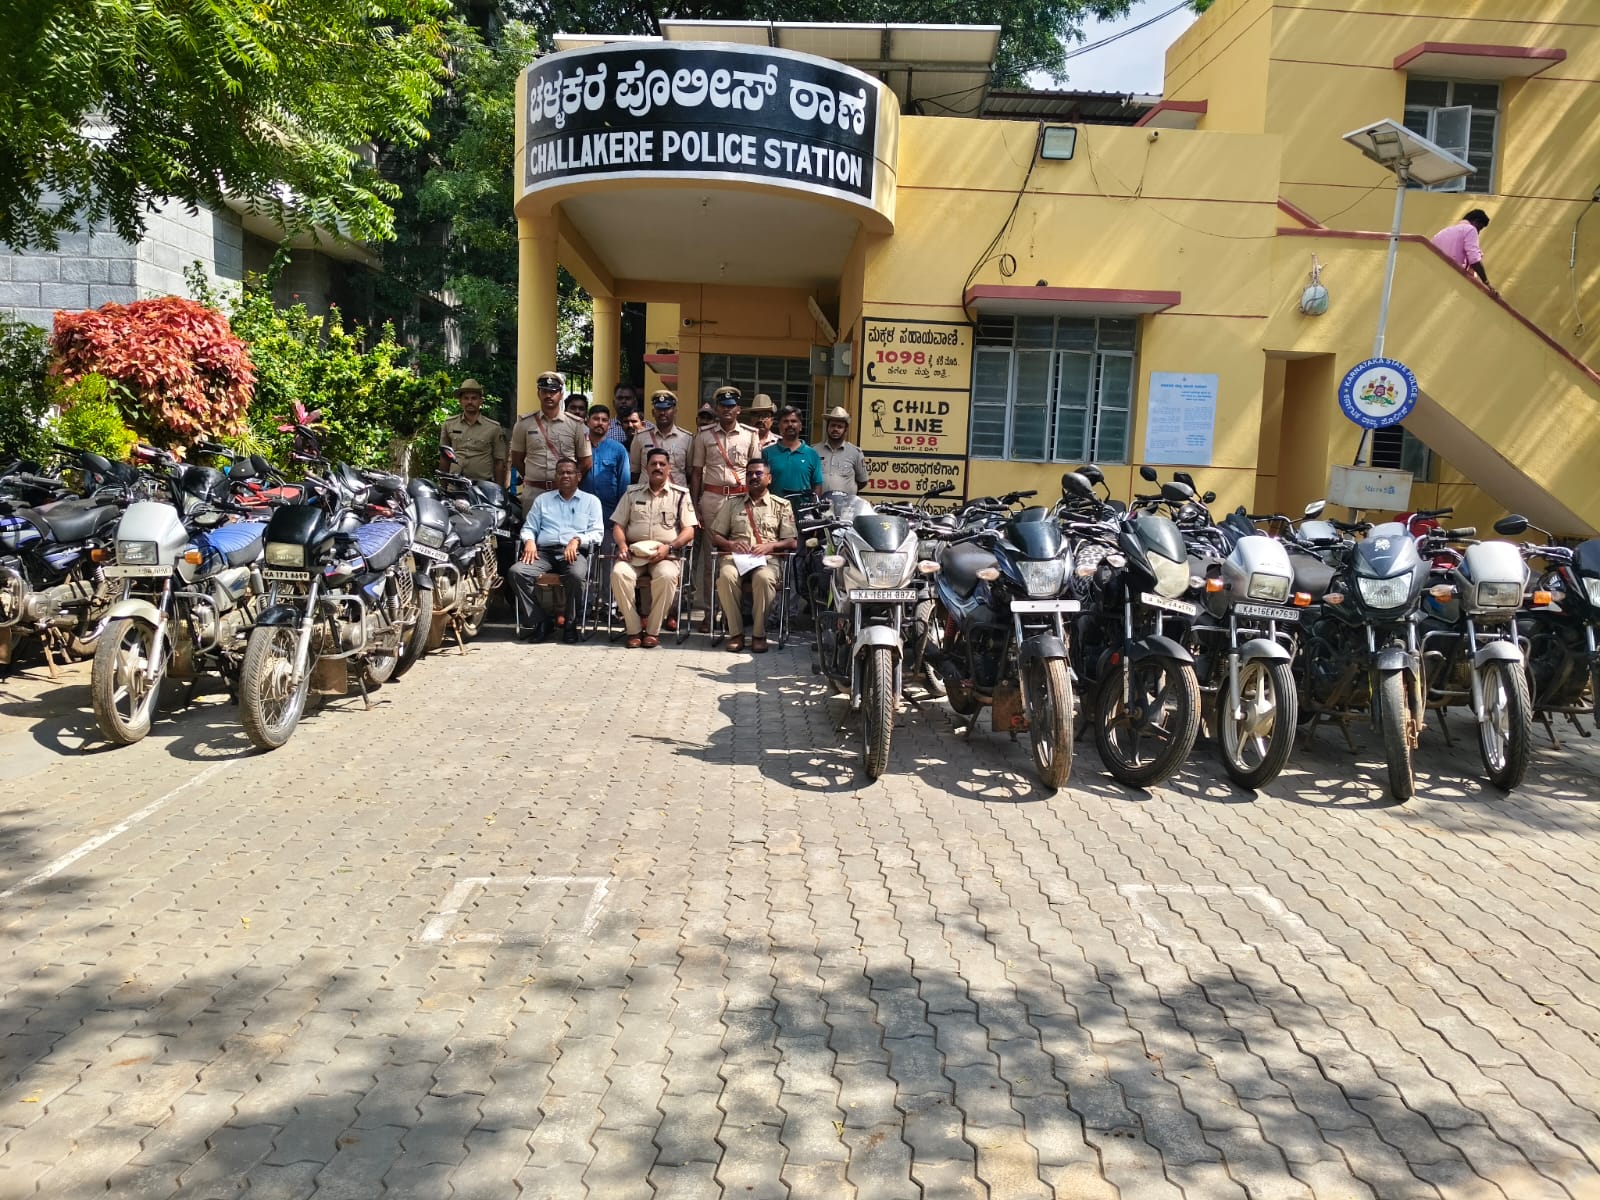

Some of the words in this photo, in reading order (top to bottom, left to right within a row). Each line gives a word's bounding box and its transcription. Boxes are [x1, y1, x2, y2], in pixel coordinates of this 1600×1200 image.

[530, 62, 607, 129] ಚಳ್ಳಕೆರೆ
[615, 60, 779, 117] ಪೊಲೀಸ್
[789, 78, 867, 136] ಠಾಣೆ
[530, 131, 653, 175] CHALLAKERE
[662, 131, 757, 166] POLICE
[764, 138, 863, 188] STATION
[876, 350, 926, 365] 1098
[1344, 358, 1385, 387] KARNATAKA
[1385, 359, 1408, 373] STATE
[1406, 372, 1418, 398] POLICE
[893, 399, 950, 416] CHILD
[893, 416, 943, 433] LINE
[895, 435, 938, 446] 1098
[868, 479, 911, 491] 1930
